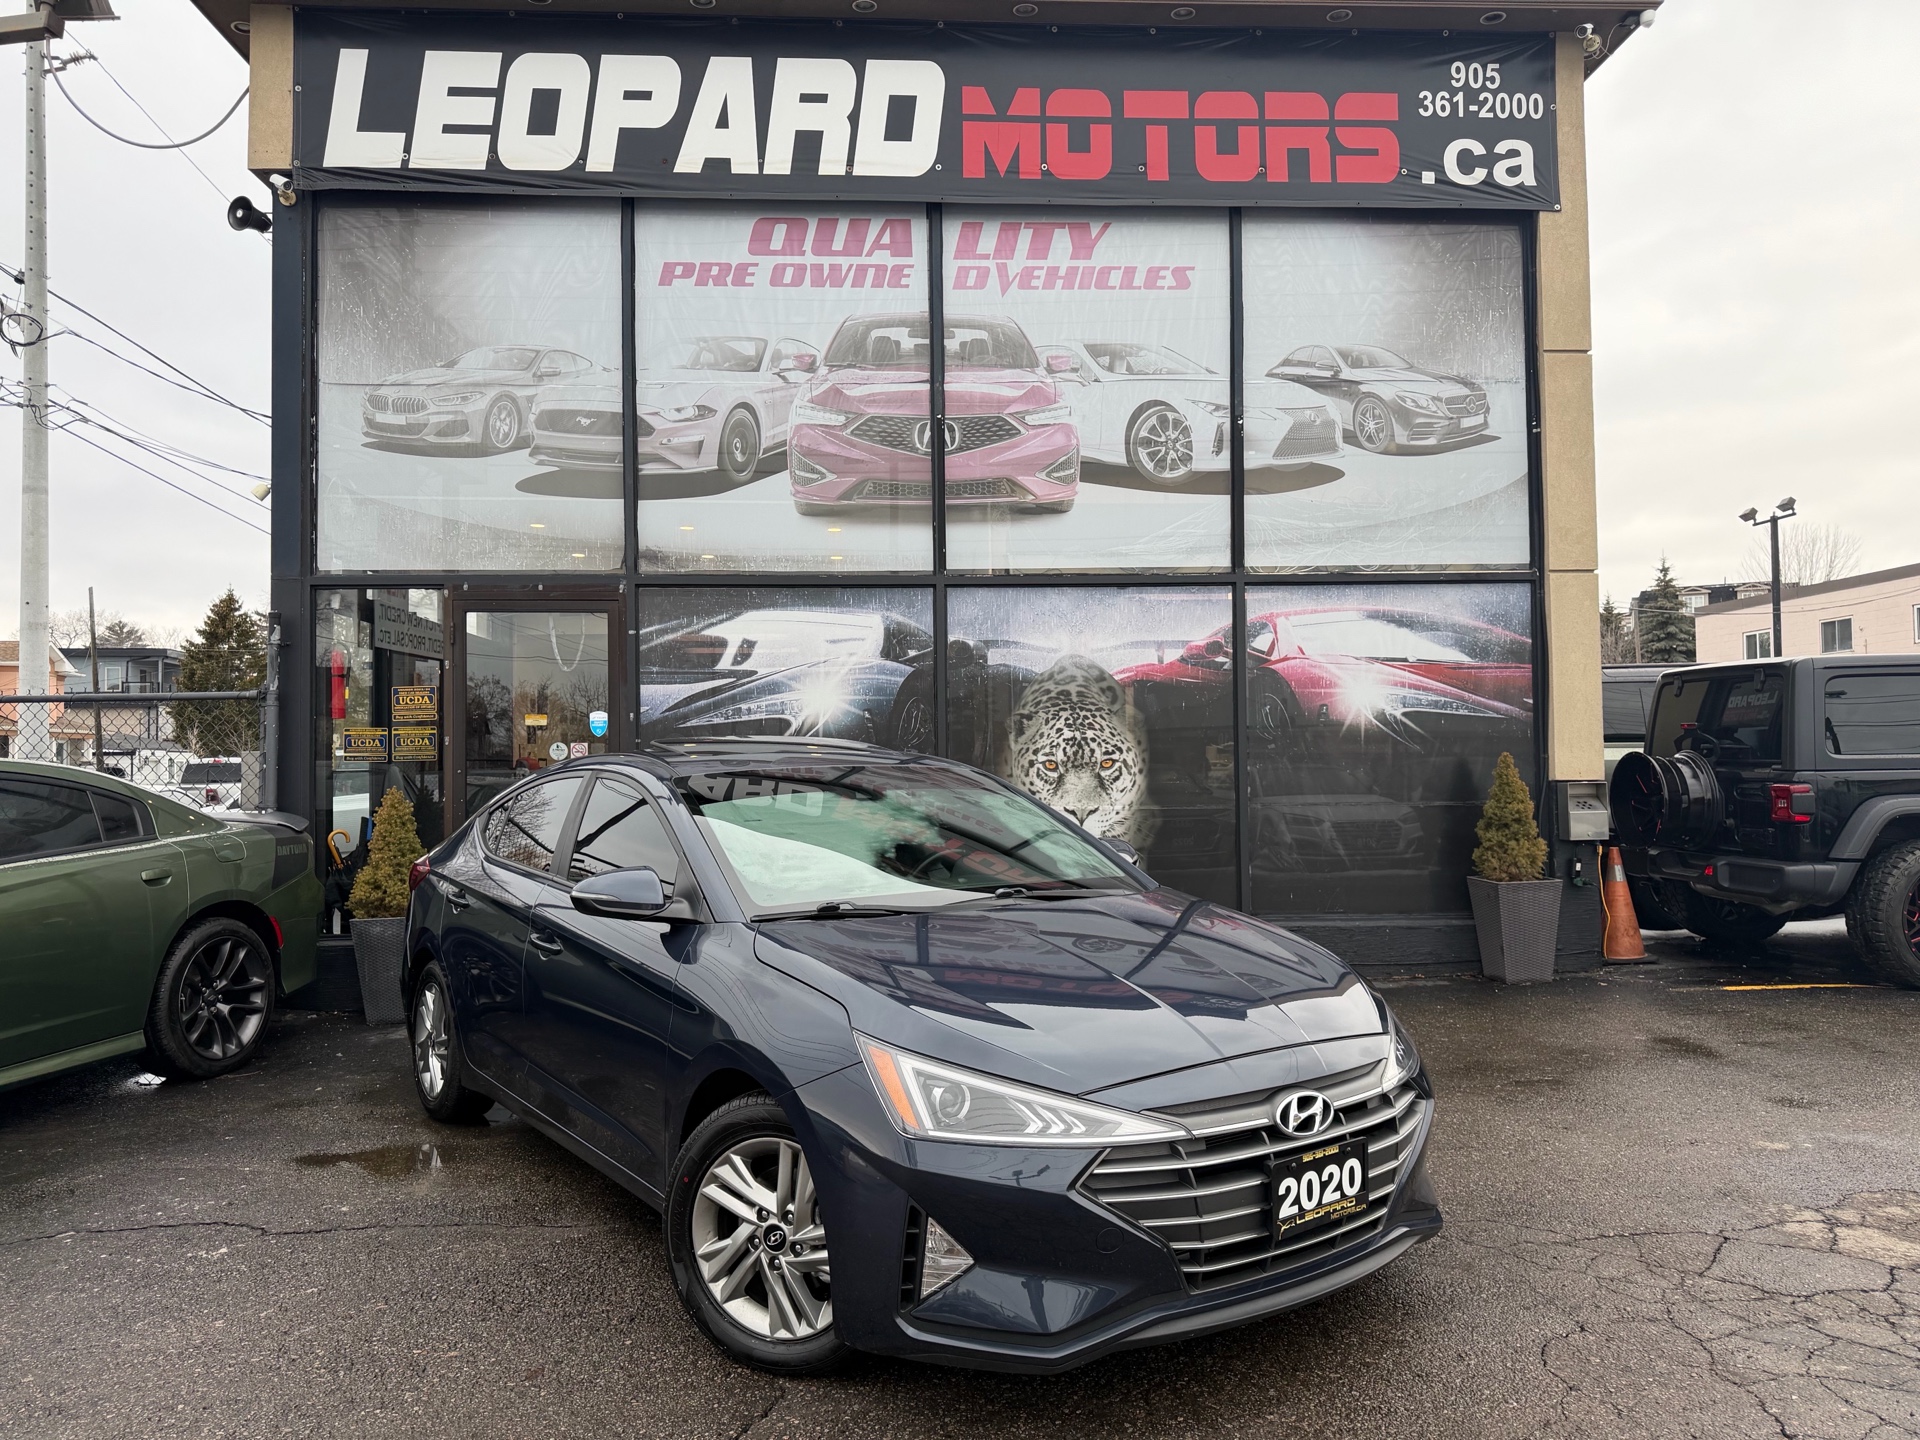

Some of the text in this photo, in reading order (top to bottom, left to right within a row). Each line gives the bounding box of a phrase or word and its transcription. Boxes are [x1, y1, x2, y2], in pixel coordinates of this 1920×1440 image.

[1450, 61, 1501, 90] 905
[323, 48, 1538, 187] LEOPARD MOTORS .ca
[1418, 90, 1544, 119] 361-2000
[747, 217, 1113, 261] QUA LITY
[658, 261, 760, 287] PRE
[768, 262, 915, 289] OWNE
[995, 261, 1196, 299] VEHICLES
[399, 695, 431, 705] UCDA
[350, 738, 381, 747] UCDA
[400, 737, 430, 746] UCDA
[277, 843, 307, 855] DAYTONA
[1278, 1157, 1362, 1219] 2020
[1296, 1197, 1356, 1224] LEOPARD
